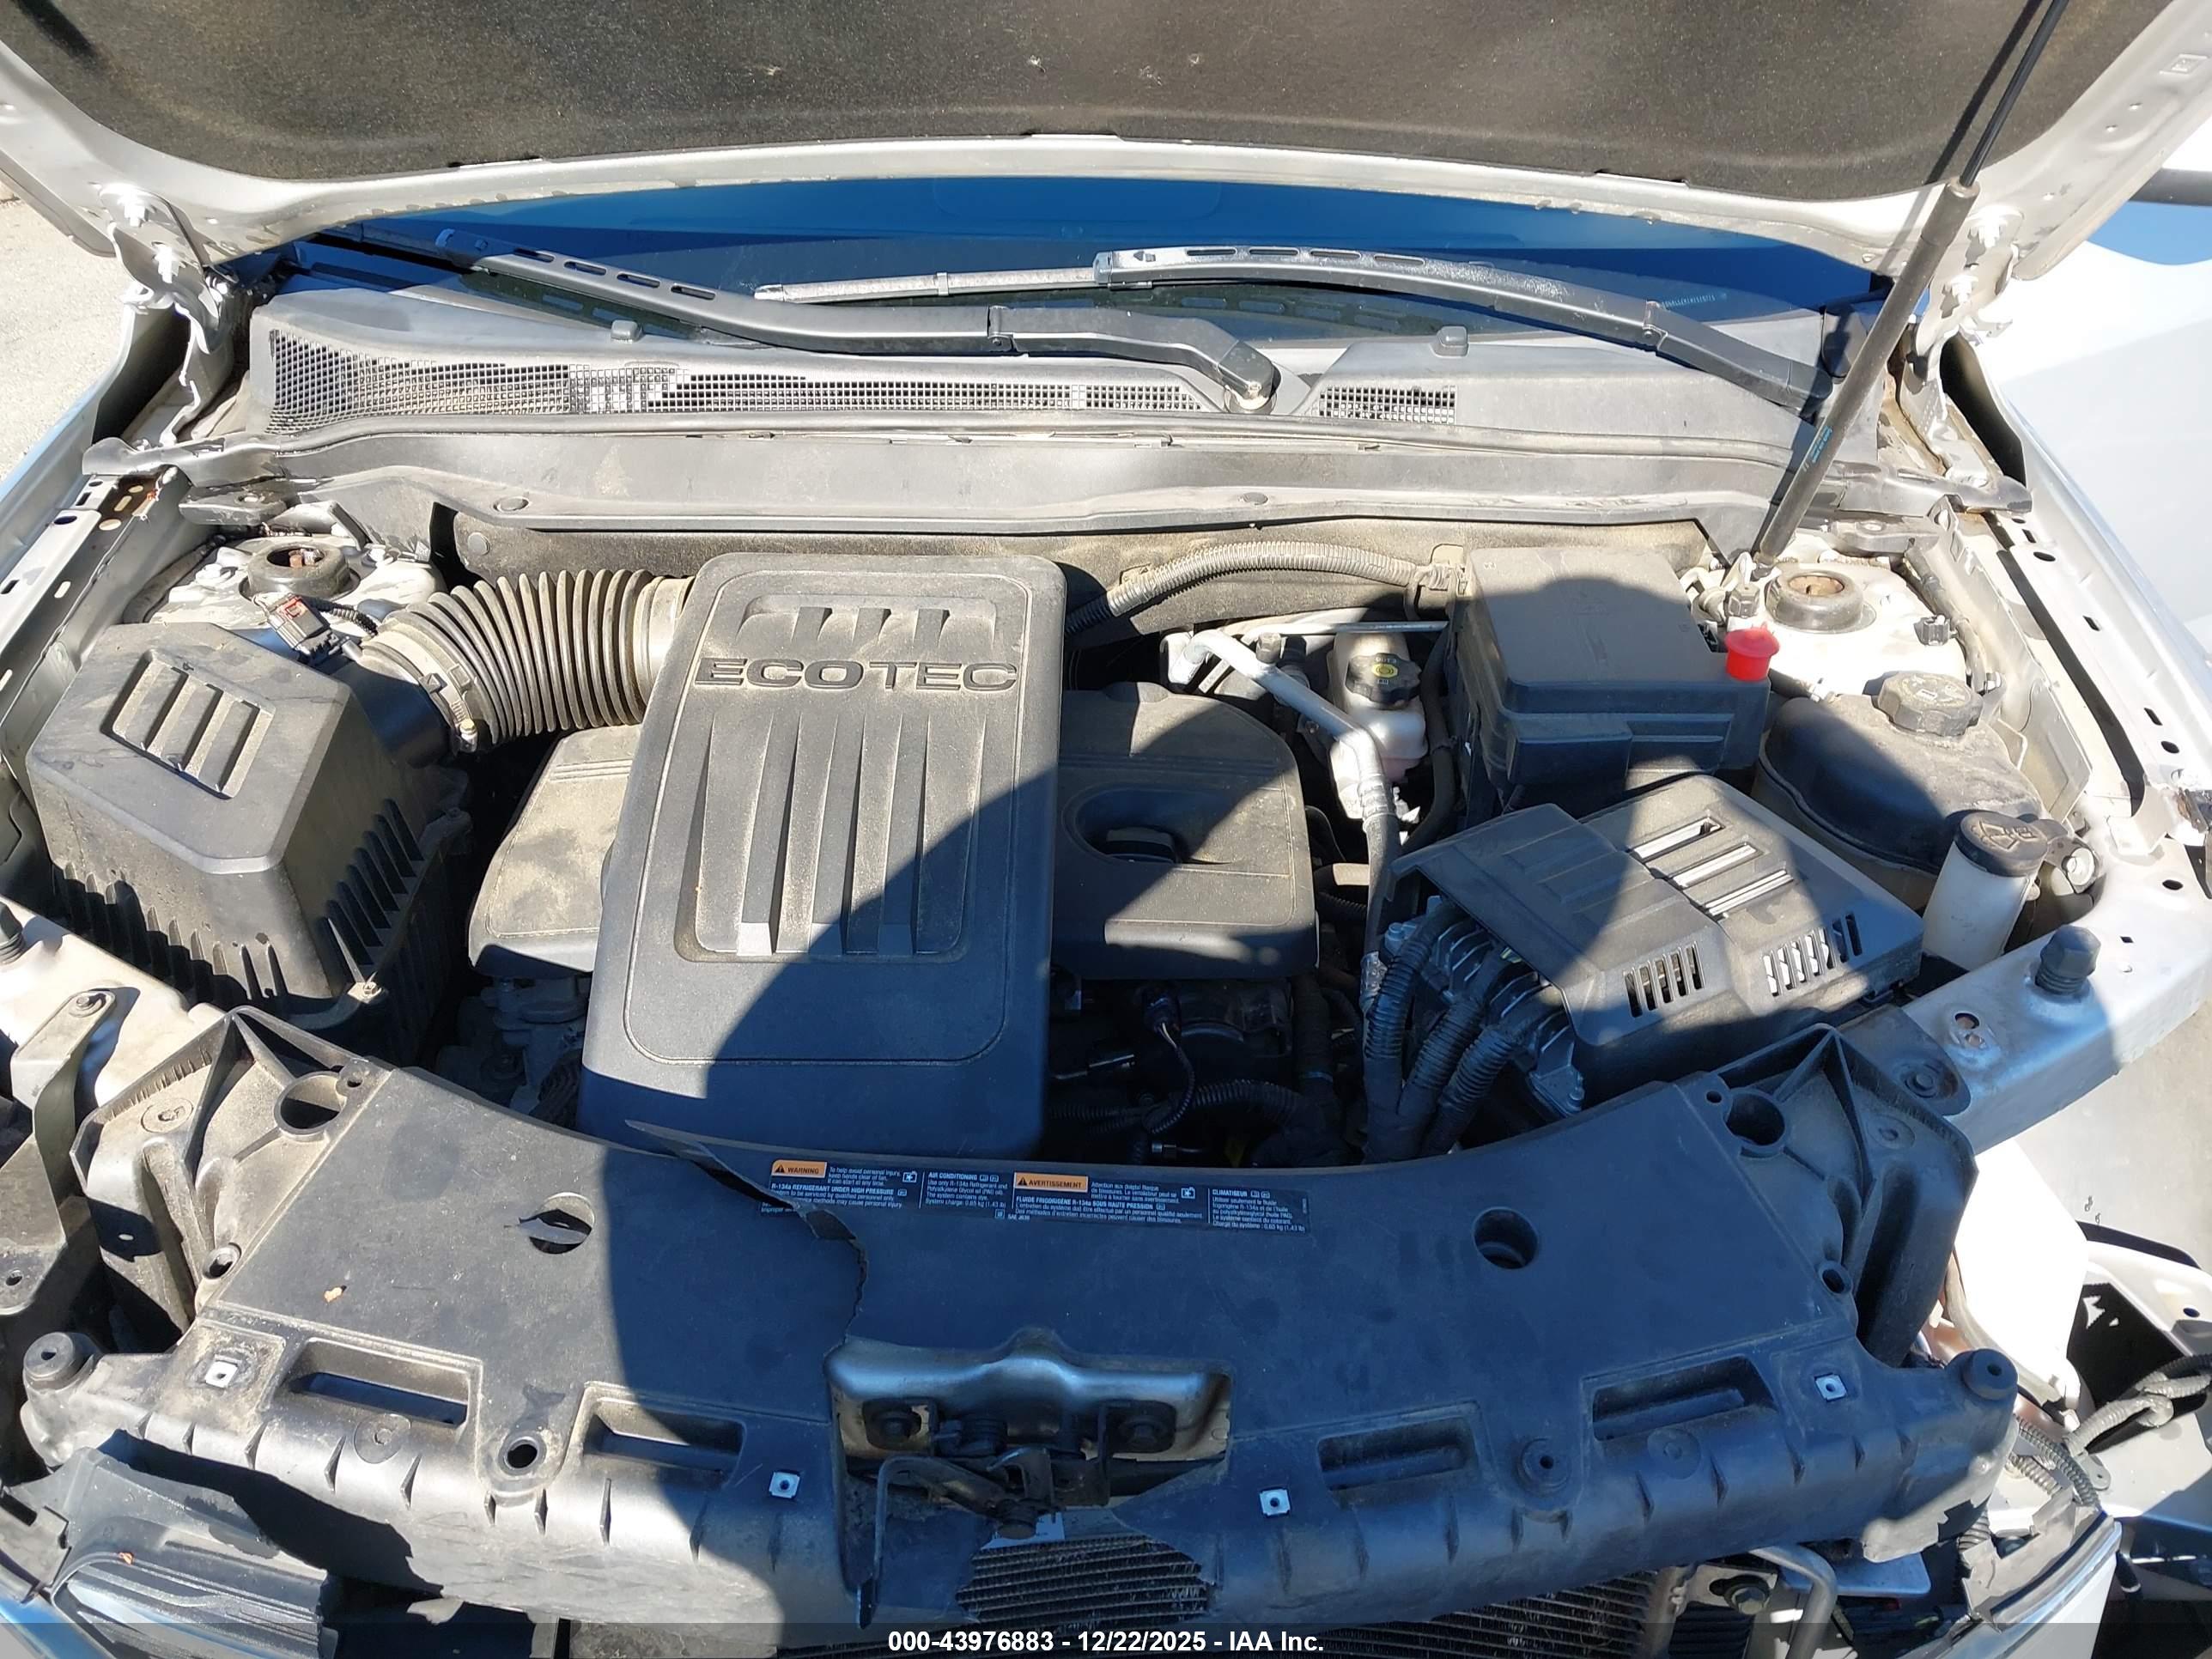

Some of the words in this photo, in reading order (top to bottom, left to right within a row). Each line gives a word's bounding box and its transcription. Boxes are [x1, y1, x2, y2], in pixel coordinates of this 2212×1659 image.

[695, 658, 1017, 691] ECOTEC
[939, 1172, 977, 1181] CONDITIONING
[792, 1183, 830, 1192] REFRIGERANT
[1029, 1179, 1082, 1189] AVERTISSEMENT
[1212, 1188, 1248, 1197] CLIMATISEUR
